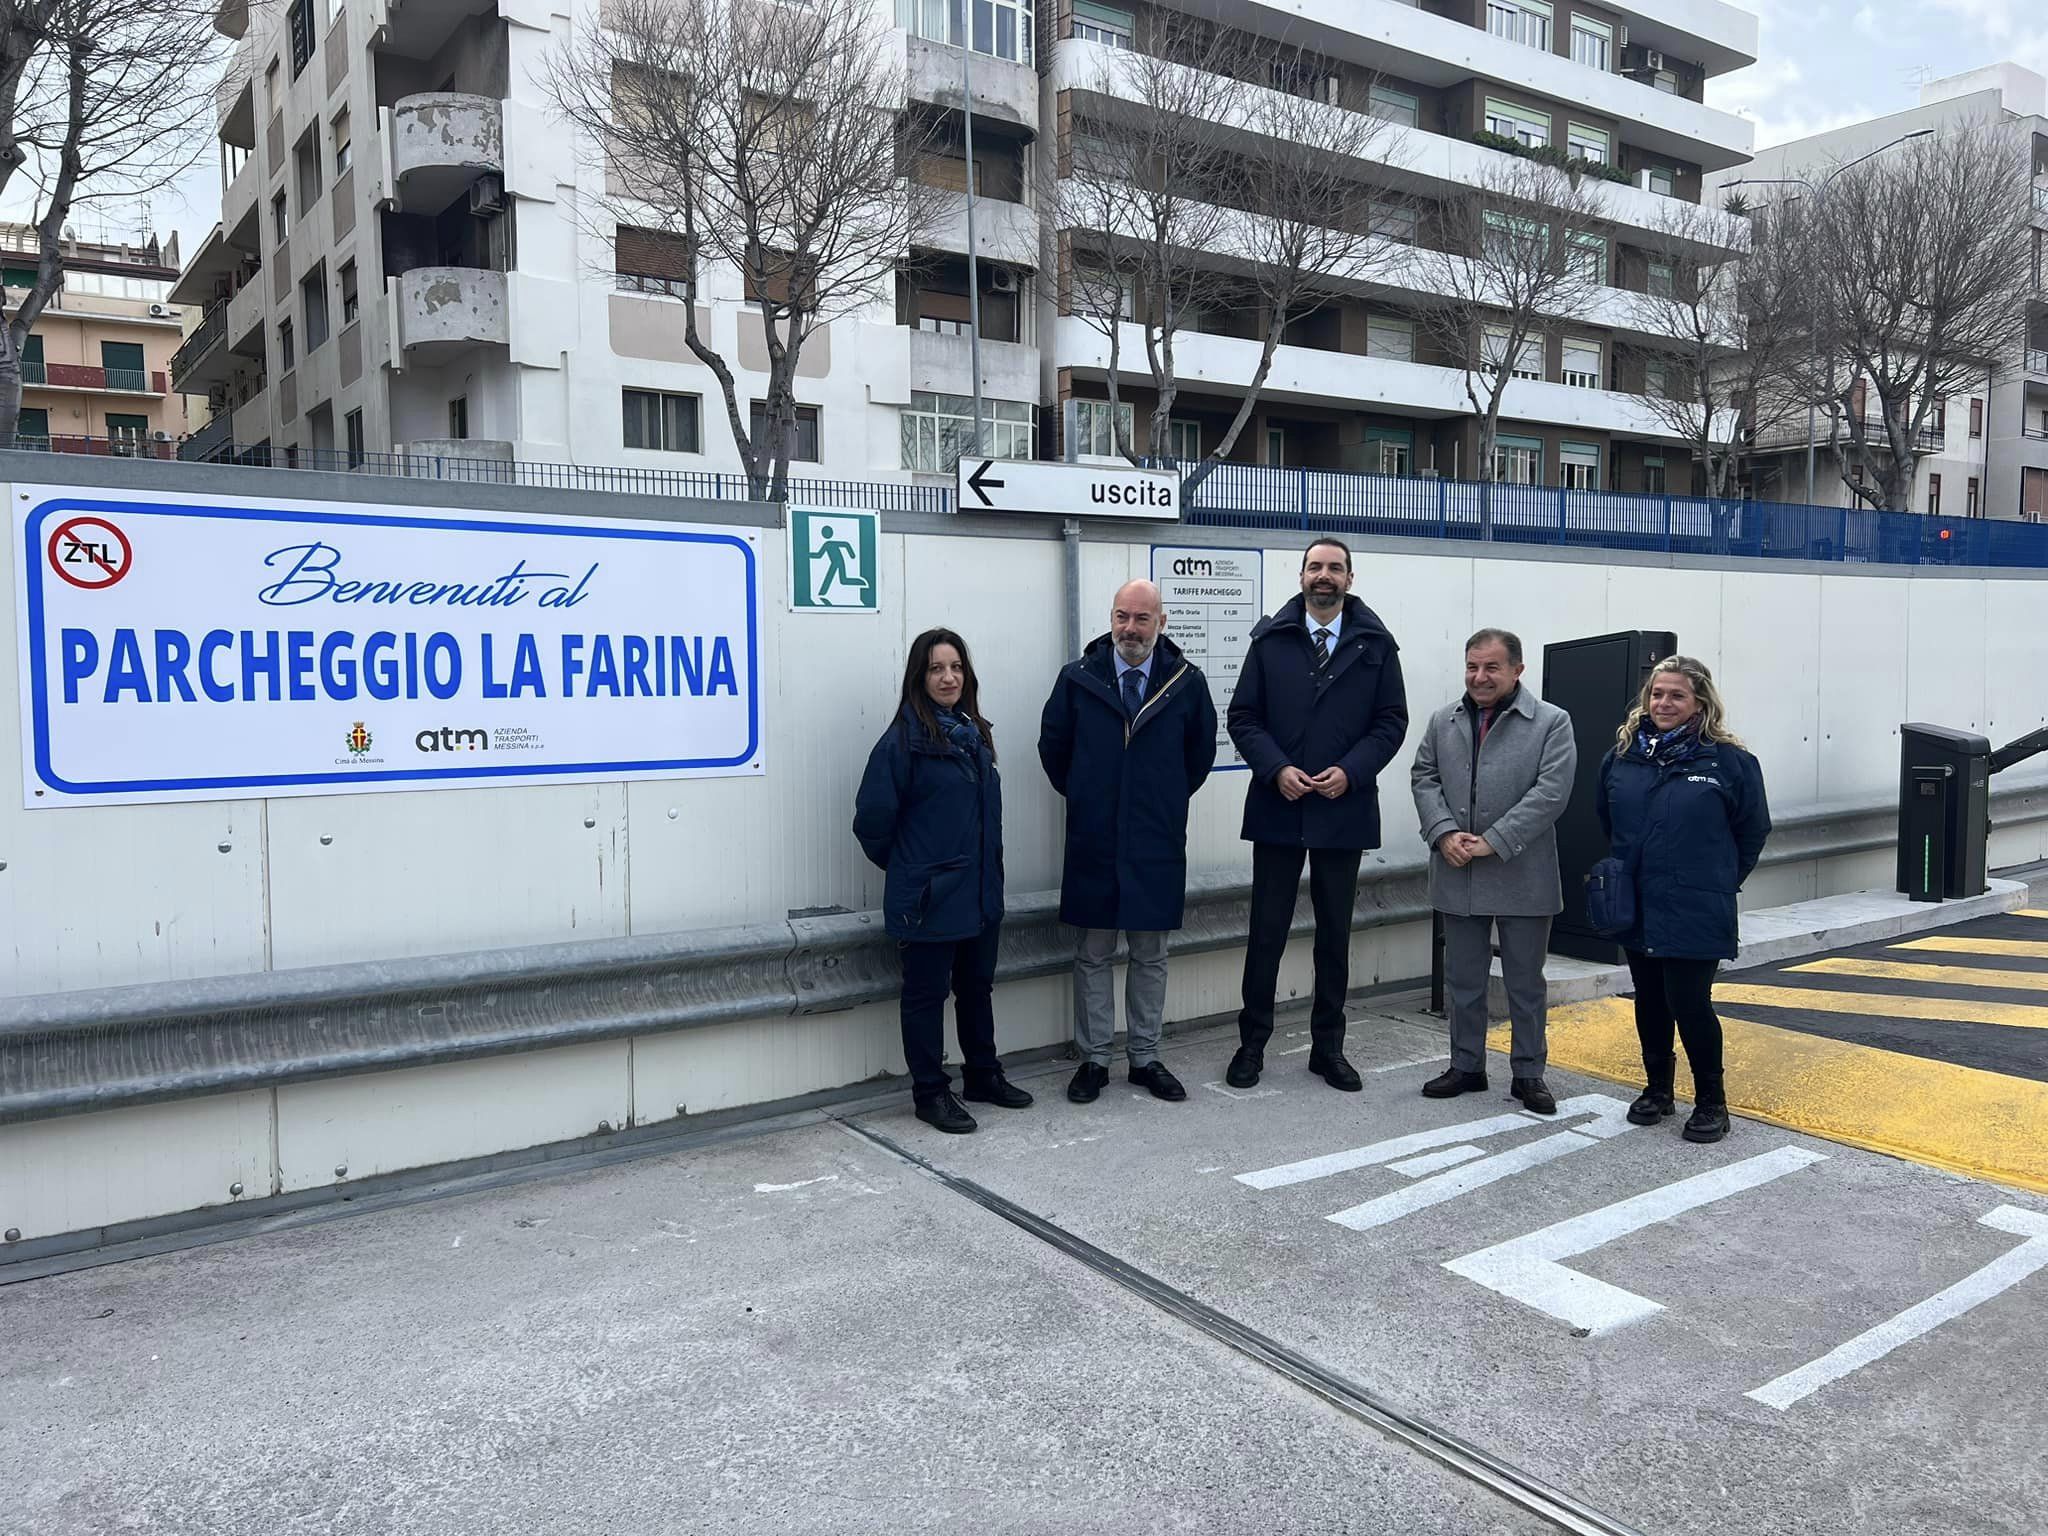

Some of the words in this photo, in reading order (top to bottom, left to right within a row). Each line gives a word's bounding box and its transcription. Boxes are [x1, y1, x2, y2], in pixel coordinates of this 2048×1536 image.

[1091, 480, 1172, 507] uscita
[63, 543, 117, 563] ZTL
[258, 541, 570, 607] Benvenuti
[538, 562, 599, 607] al
[1173, 557, 1212, 576] atm
[1173, 587, 1199, 595] TARIFFE
[1200, 588, 1242, 597] PARCHEGGIO
[60, 628, 463, 704] PARCHEGGIO
[480, 632, 547, 699] LA
[562, 634, 738, 697] FARINA
[415, 726, 489, 752] atm
[494, 728, 528, 736] AZIENDA
[494, 735, 539, 743] TRASPORTI
[494, 742, 530, 751] MESSINA
